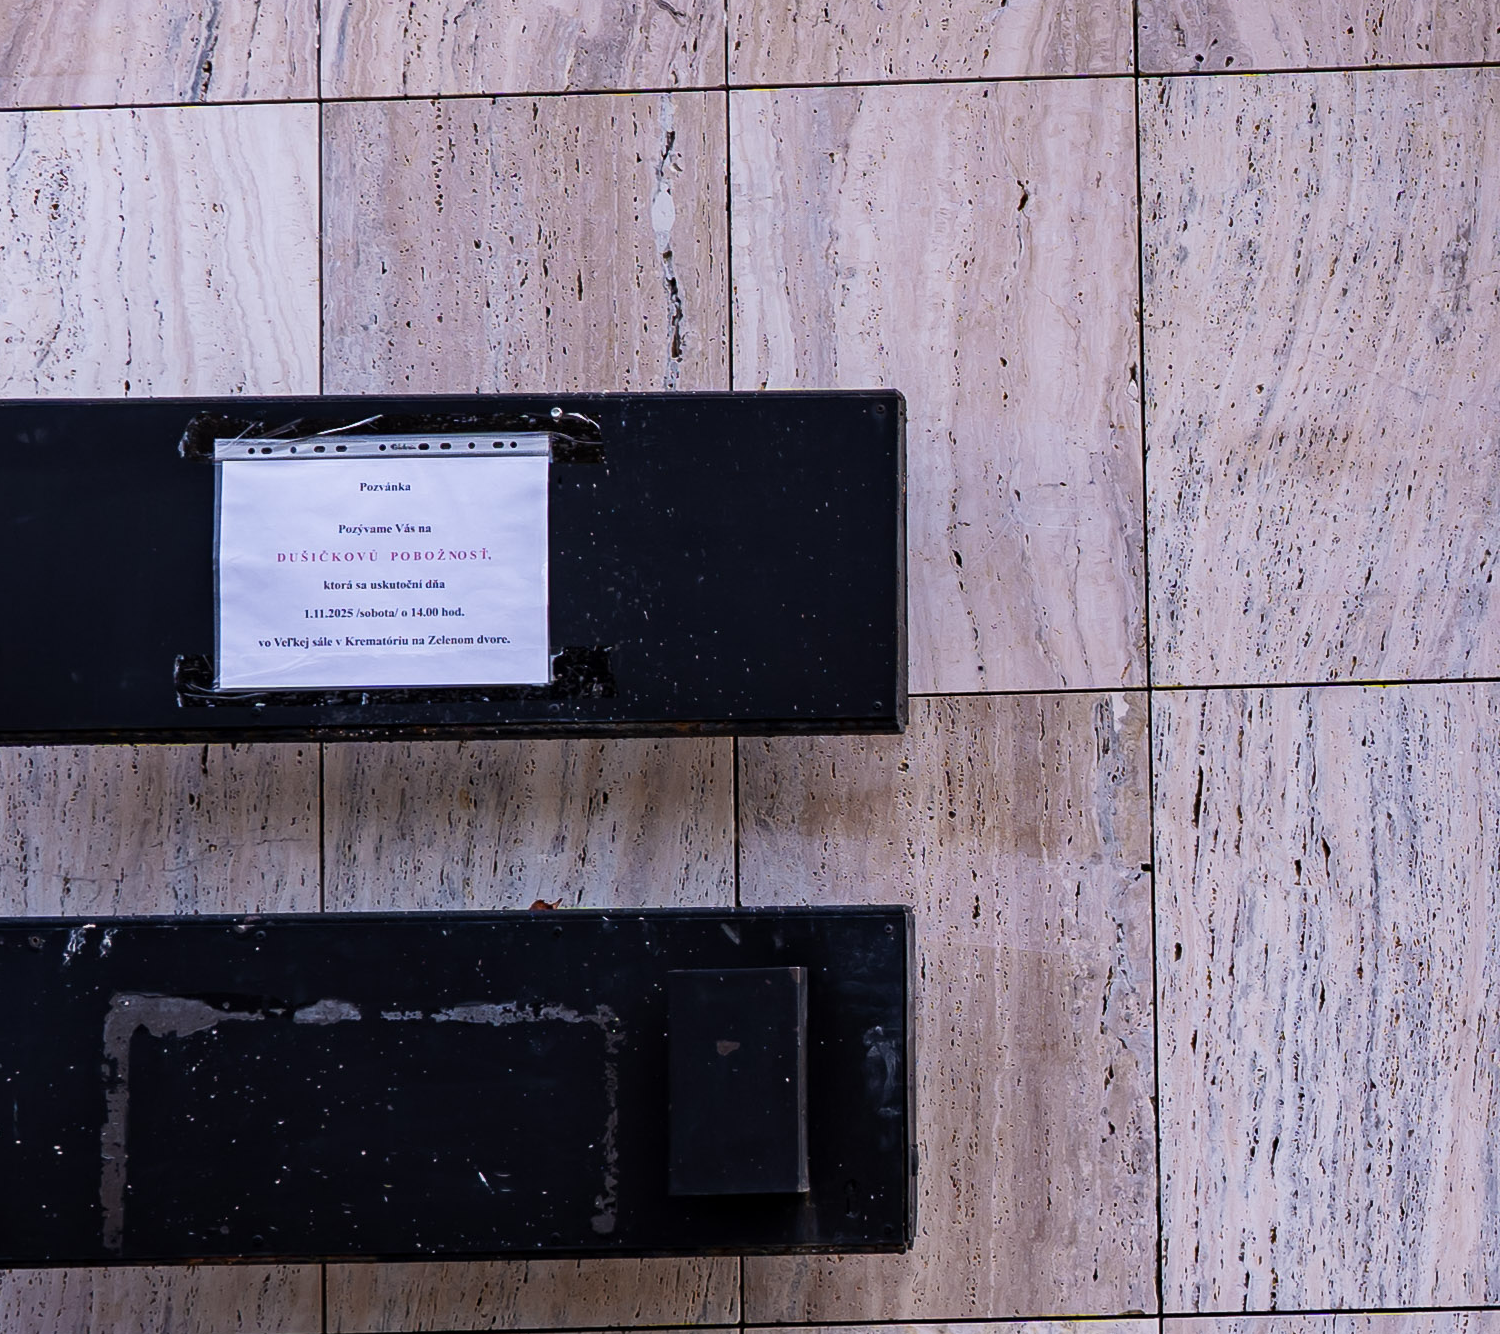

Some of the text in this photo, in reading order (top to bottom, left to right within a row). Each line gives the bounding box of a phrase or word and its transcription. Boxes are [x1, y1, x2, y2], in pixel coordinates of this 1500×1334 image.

[359, 481, 411, 492] Pozvánka
[338, 522, 432, 537] Pozývame Vás na
[323, 578, 446, 591] ktorá sa uskutoční dňa
[304, 606, 466, 619] 1.11.2025 /sobota/ o 14.00 hod.
[258, 639, 272, 648] vo
[311, 636, 333, 647] sále
[335, 638, 342, 646] v
[345, 635, 409, 647] Krematóriu
[411, 637, 425, 646] na
[427, 634, 474, 646] Zelenom
[476, 634, 511, 645] dvore.
